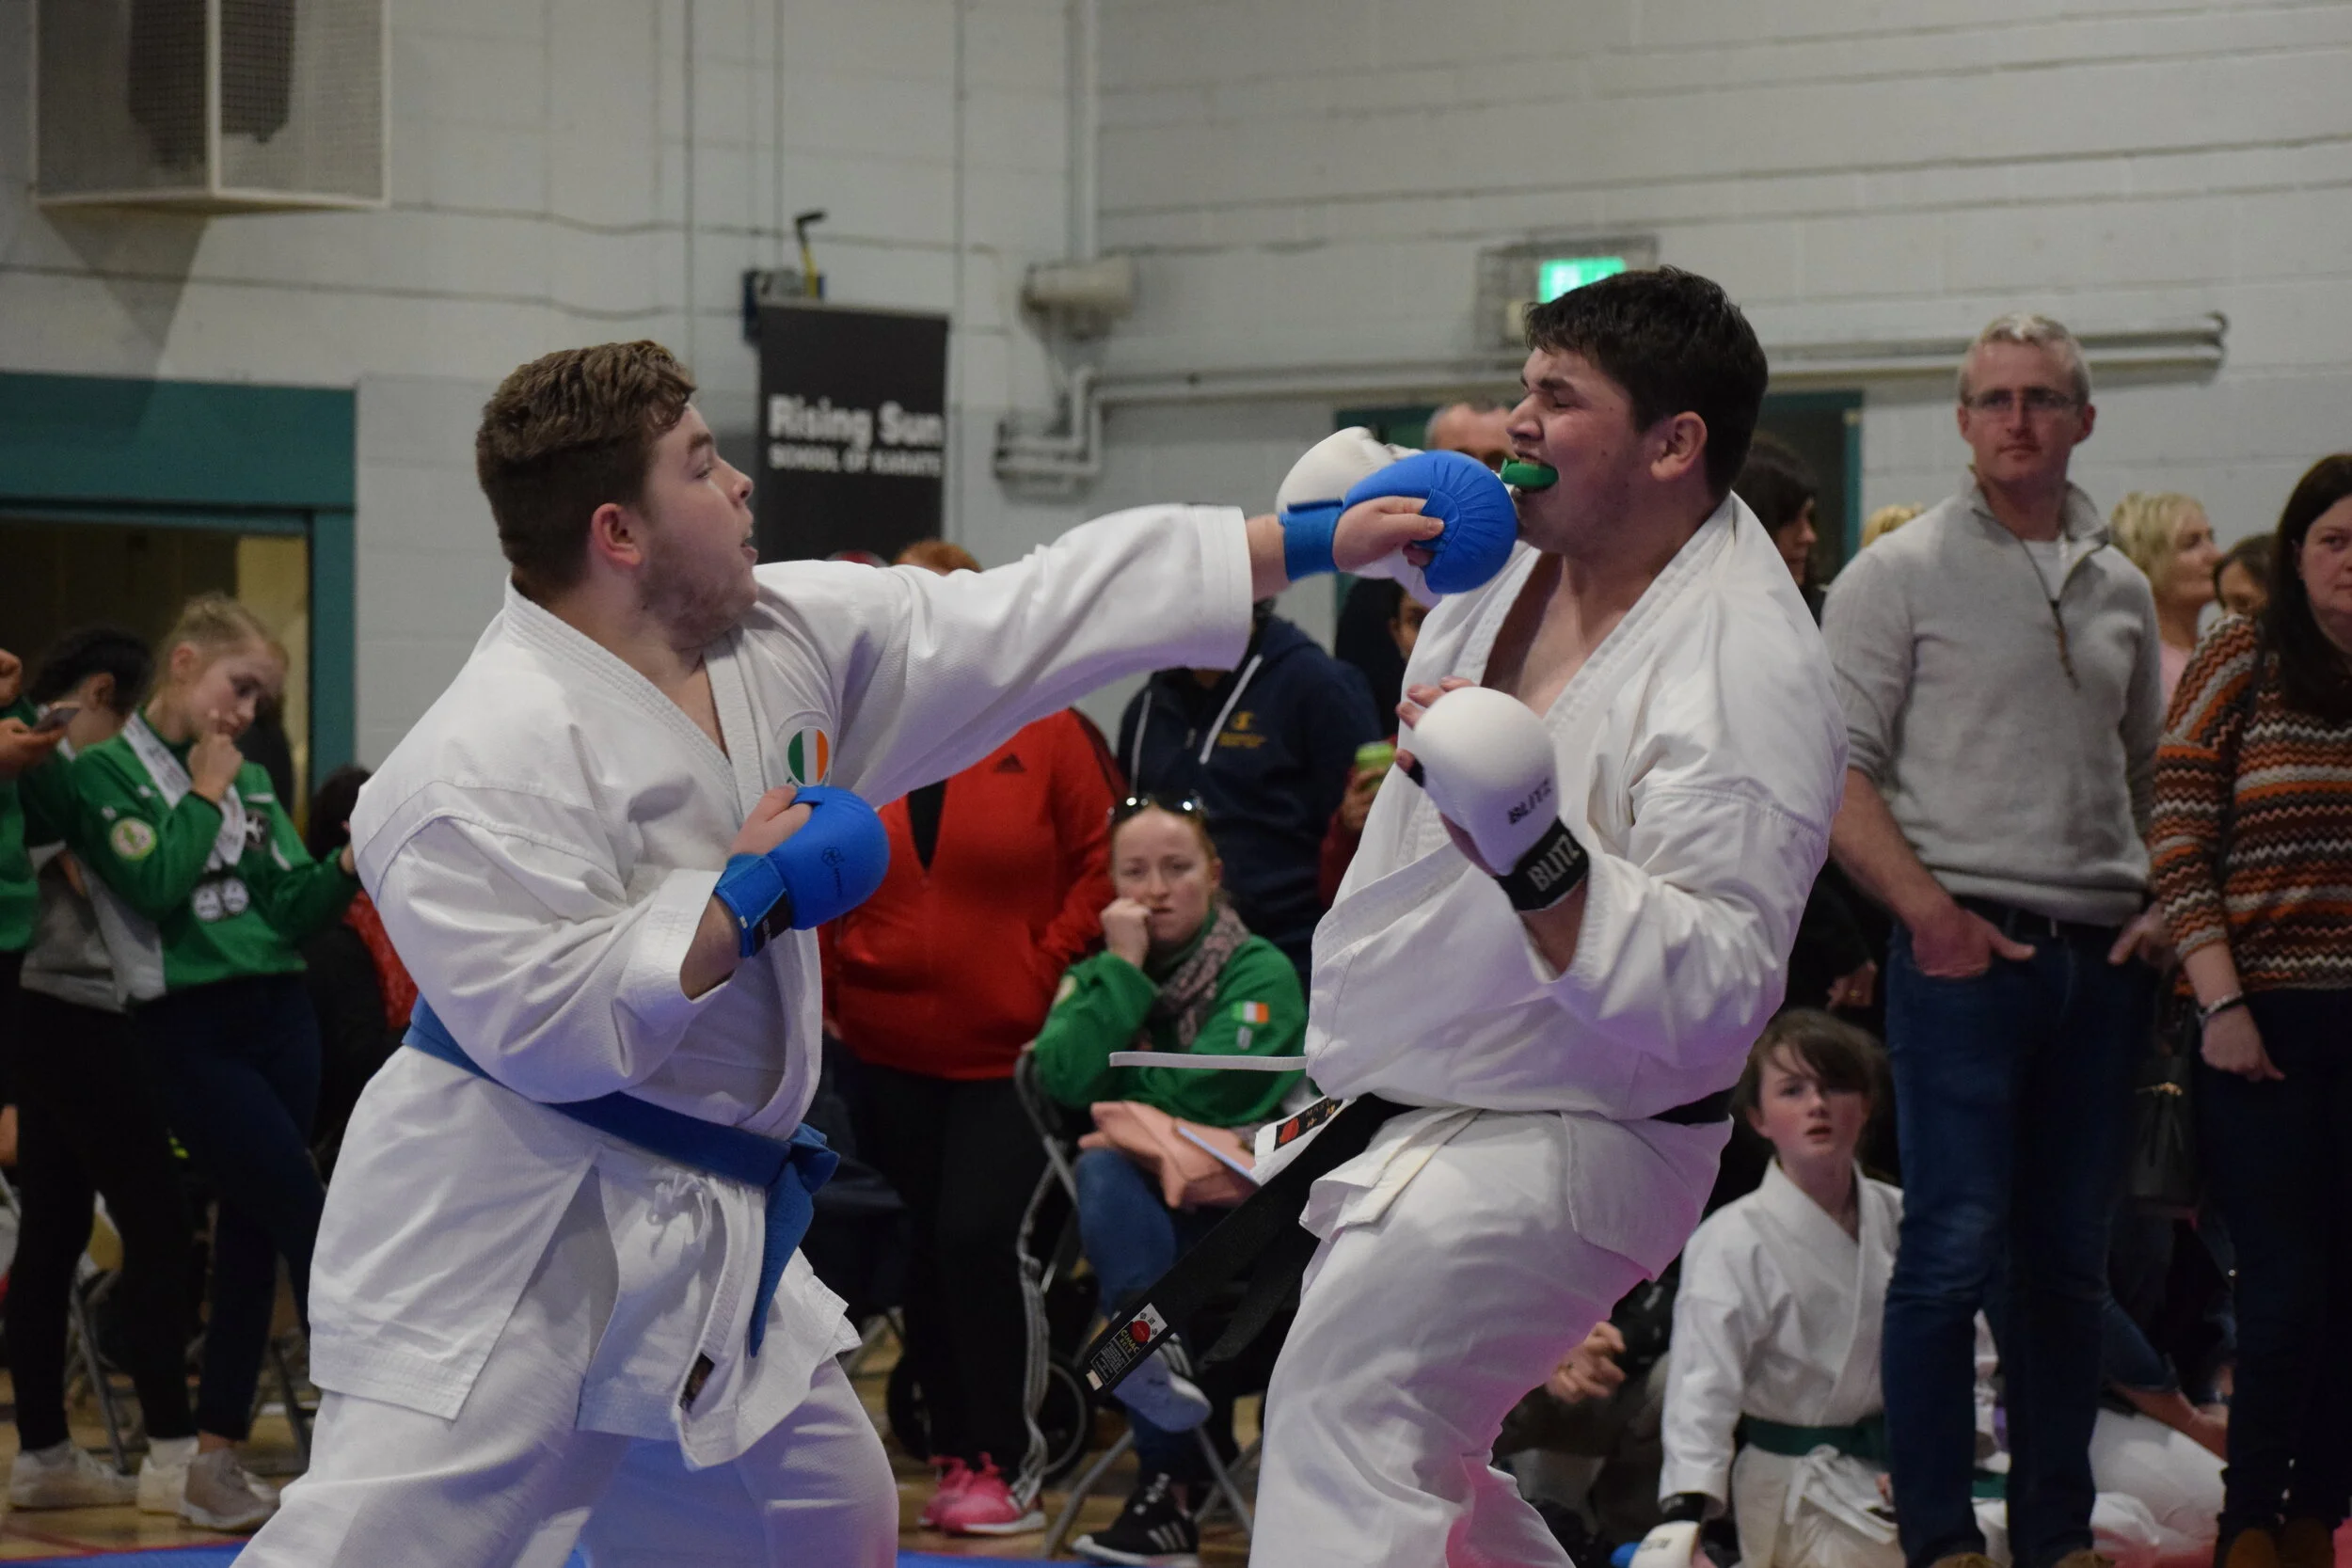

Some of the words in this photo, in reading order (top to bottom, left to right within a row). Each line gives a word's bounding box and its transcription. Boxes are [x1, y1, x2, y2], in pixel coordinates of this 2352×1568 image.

[769, 393, 873, 451] Rising
[878, 401, 943, 447] Sun
[1507, 778, 1551, 825] BLITZ
[1526, 833, 1581, 892] BLITZ
[1120, 1329, 1140, 1354] CIMAC
